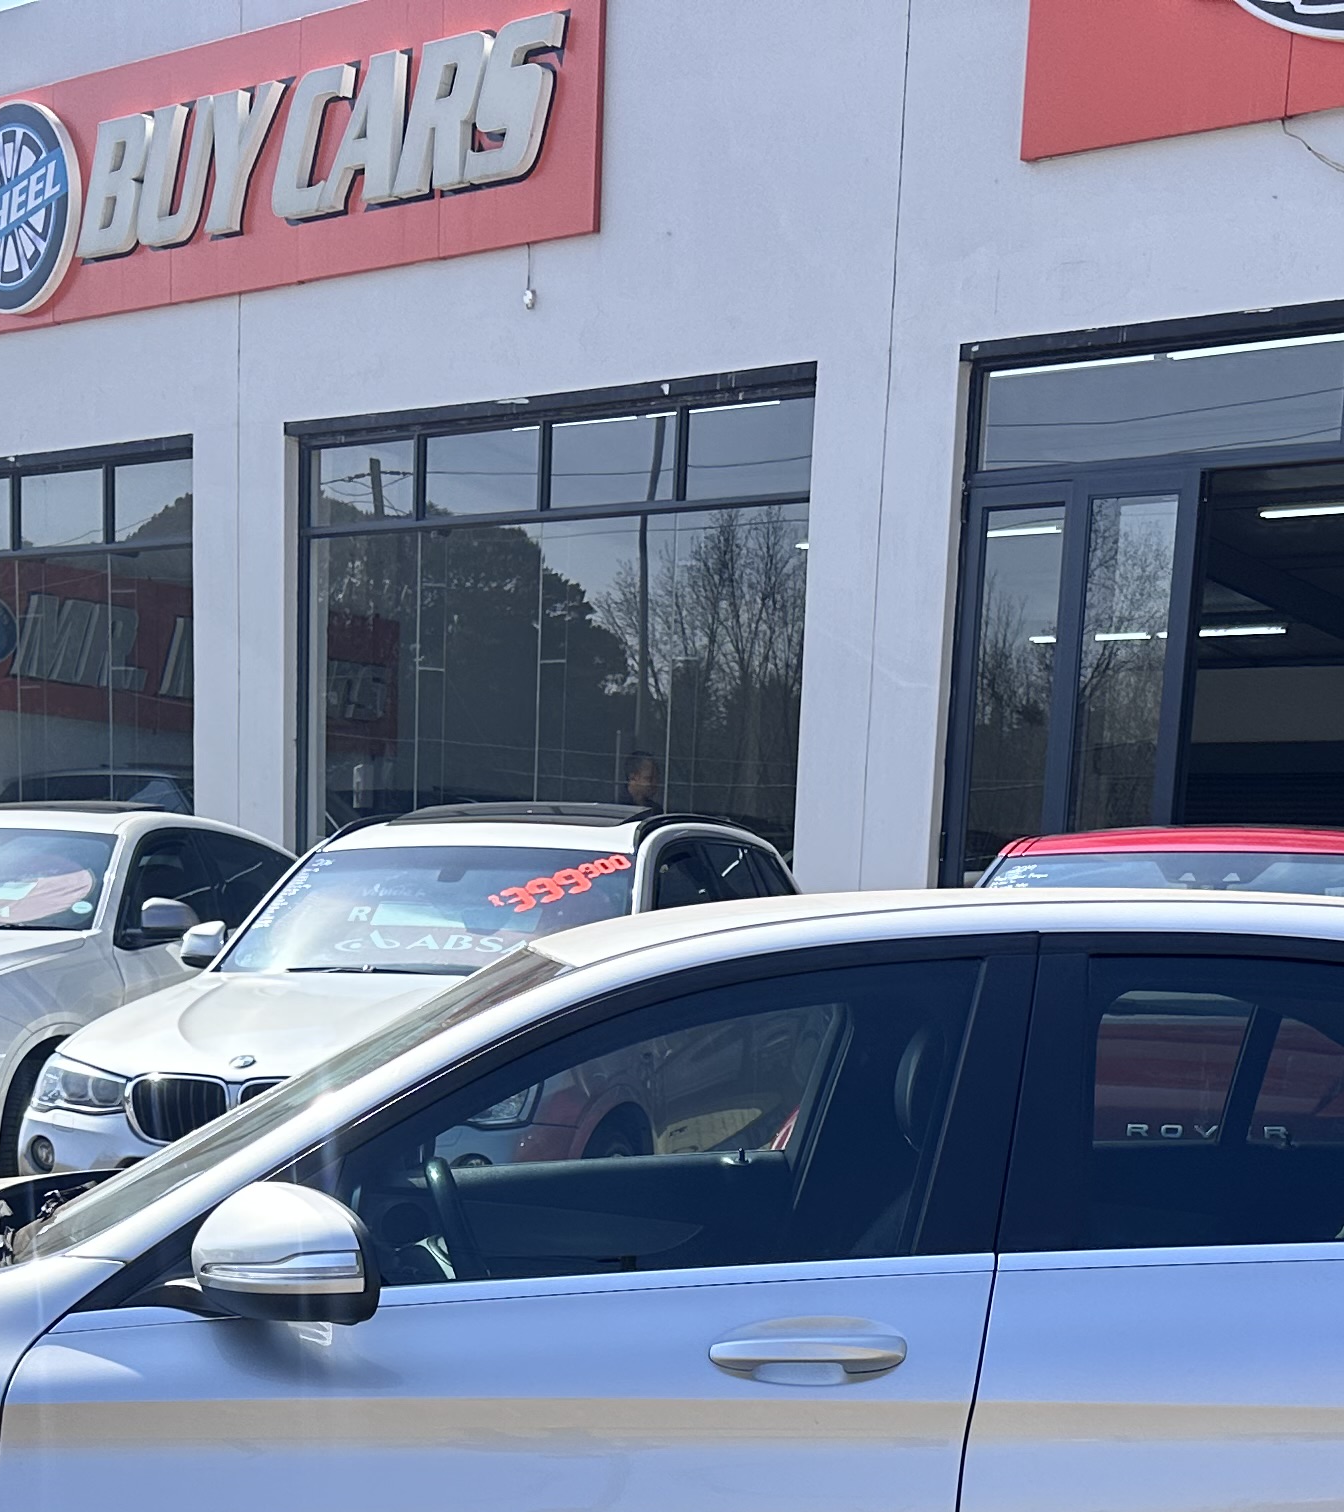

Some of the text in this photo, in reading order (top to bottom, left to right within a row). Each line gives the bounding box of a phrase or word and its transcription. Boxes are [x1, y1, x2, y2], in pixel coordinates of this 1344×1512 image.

[76, 9, 570, 263] BUY CARS
[1125, 1123, 1288, 1141] ROVR
